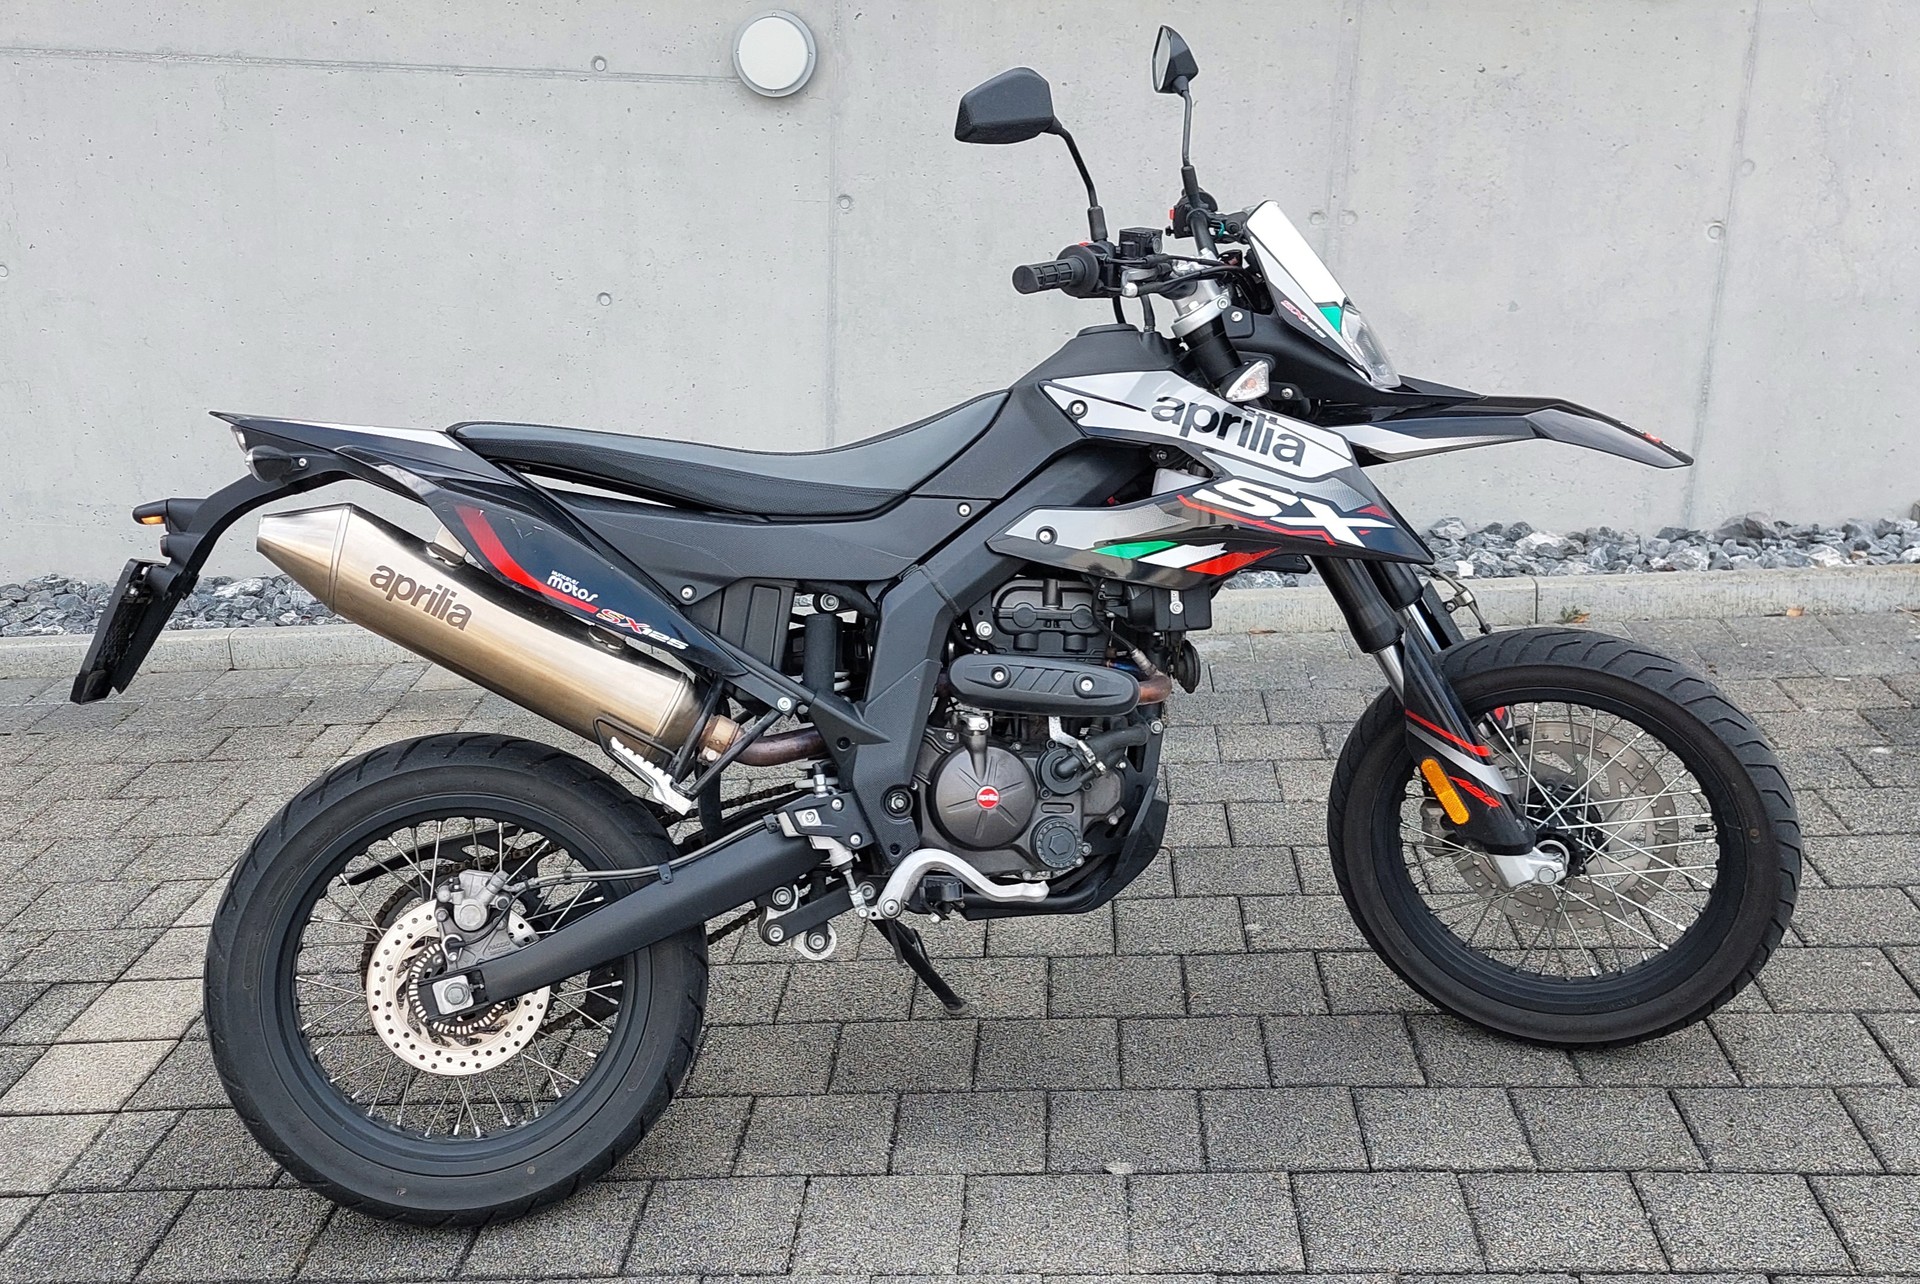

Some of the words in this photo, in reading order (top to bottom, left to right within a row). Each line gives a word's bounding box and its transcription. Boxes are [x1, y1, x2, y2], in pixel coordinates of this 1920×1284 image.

[1151, 393, 1307, 467] aprilia
[1191, 478, 1395, 548] SX
[369, 564, 473, 631] aprilia
[546, 575, 599, 602] motos
